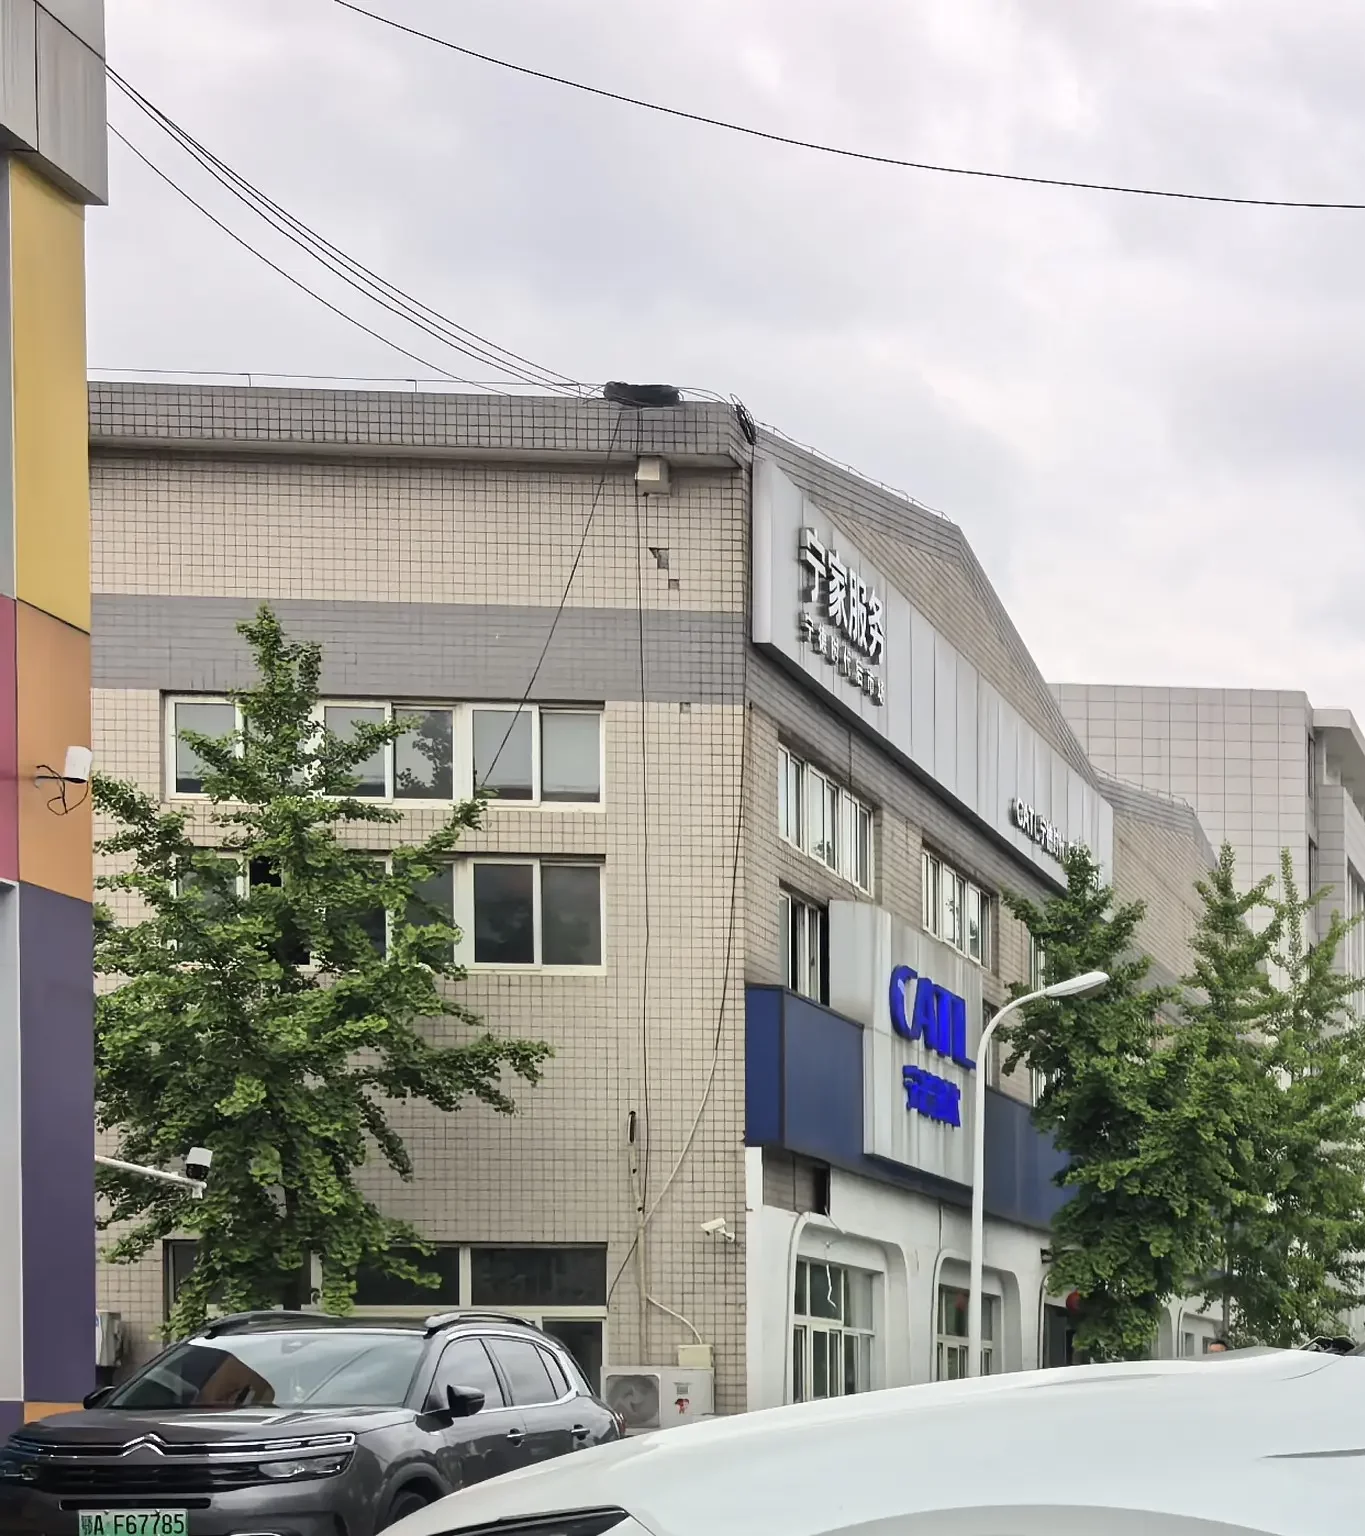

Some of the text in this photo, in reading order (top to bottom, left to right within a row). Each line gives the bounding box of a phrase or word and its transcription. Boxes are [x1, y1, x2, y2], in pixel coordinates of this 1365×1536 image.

[799, 527, 884, 665] 宁家服务
[1013, 797, 1041, 842] CATL
[889, 964, 977, 1070] CATL
